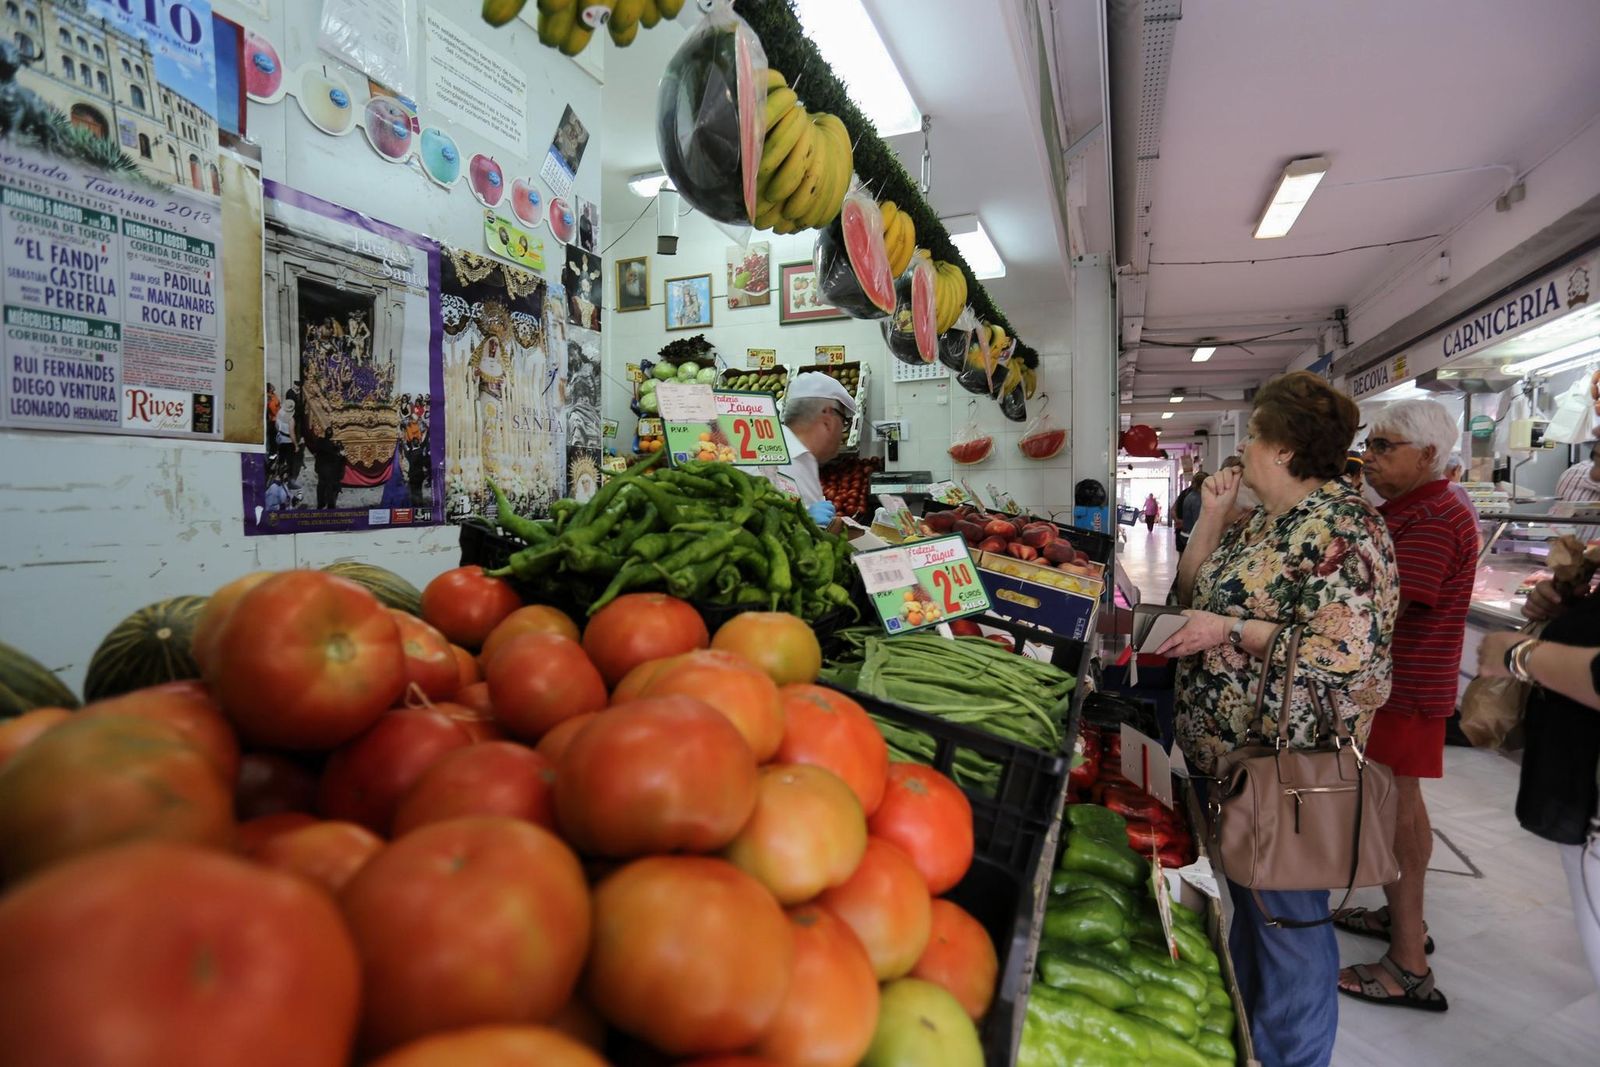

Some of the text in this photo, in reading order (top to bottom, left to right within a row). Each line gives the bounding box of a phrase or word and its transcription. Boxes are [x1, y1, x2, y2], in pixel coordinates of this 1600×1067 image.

[57, 190, 113, 212] FESTEJOS
[83, 174, 158, 209] Taurina
[164, 202, 211, 224] 2018
[9, 210, 59, 231] CORRIDA
[62, 222, 75, 234] DE
[77, 226, 111, 244] TOROS
[130, 240, 169, 258] CORRIDA
[171, 250, 182, 261] DE
[183, 253, 210, 269] TOROS
[352, 231, 408, 265] Jueves
[50, 267, 116, 297] CASTELLA
[163, 271, 211, 297] PADILLA
[382, 258, 428, 288] Santo
[45, 286, 107, 316] PERERA
[147, 286, 215, 316] MANZANARES
[142, 305, 204, 331] ROCA REY
[1443, 281, 1560, 358] CARNICERIA
[8, 328, 57, 345] CORRIDA
[61, 335, 74, 347] DE
[76, 338, 118, 353] REJONES
[14, 355, 115, 383] RUI FERNANDES
[1353, 366, 1389, 397] RECOVA
[12, 376, 116, 403] DIEGO VENTURA
[10, 397, 70, 418] LEONARDO
[125, 389, 184, 423] Rives
[512, 414, 564, 433] SANTA
